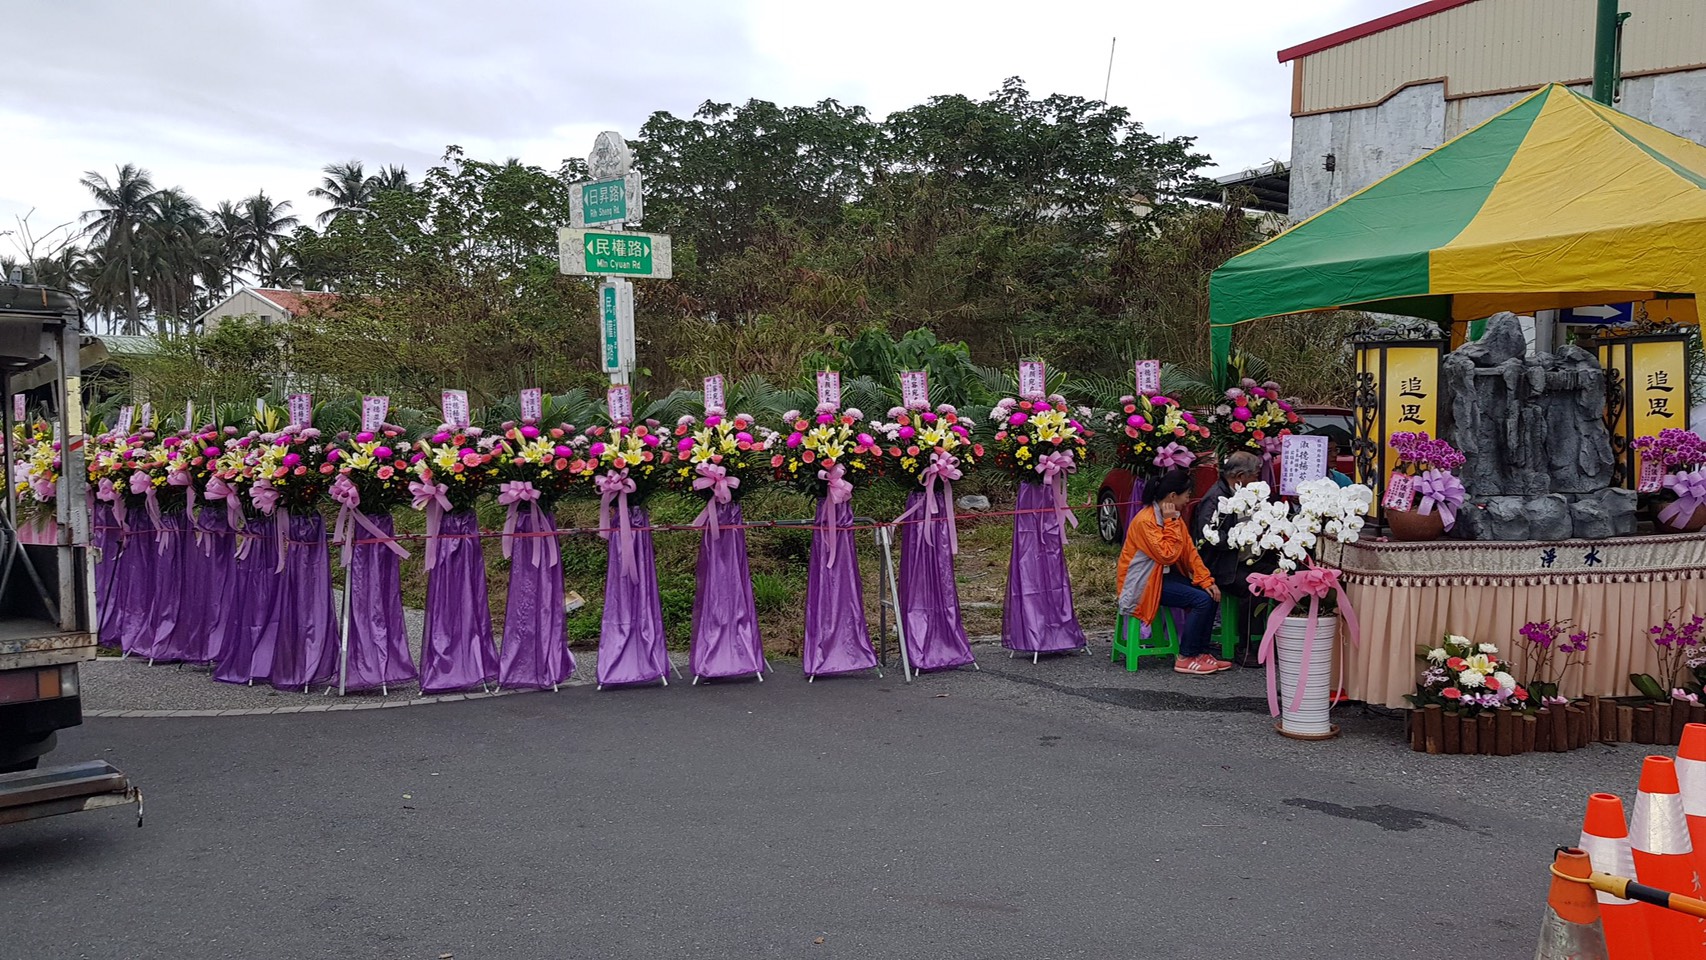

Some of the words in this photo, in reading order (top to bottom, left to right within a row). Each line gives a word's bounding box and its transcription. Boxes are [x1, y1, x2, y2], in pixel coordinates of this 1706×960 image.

[590, 185, 619, 206] 日昇路
[595, 238, 642, 257] 民權路
[597, 259, 608, 268] Min
[610, 259, 630, 270] Cyuan
[1398, 376, 1427, 425] 追思
[1646, 370, 1674, 418] 追思
